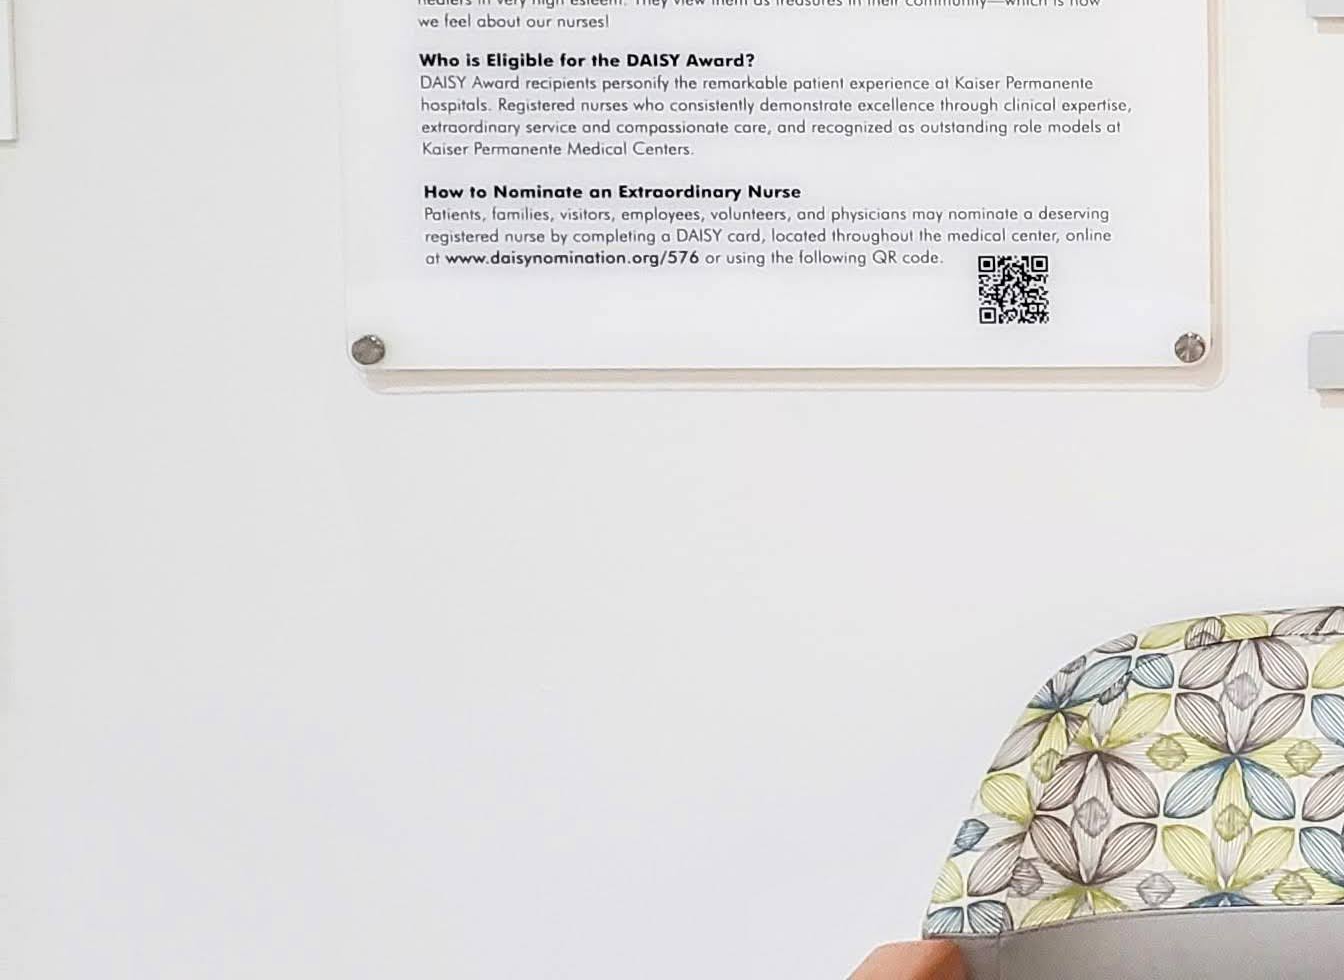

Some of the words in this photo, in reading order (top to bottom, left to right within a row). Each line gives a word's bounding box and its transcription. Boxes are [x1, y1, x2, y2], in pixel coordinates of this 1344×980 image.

[419, 52, 459, 67] Who
[466, 53, 480, 67] is
[486, 52, 554, 70] Eligible
[560, 52, 586, 67] for
[591, 52, 620, 67] the
[627, 53, 680, 67] DAISY
[686, 53, 754, 67] Award?
[422, 141, 469, 155] Kaiser
[474, 141, 562, 155] Permanente
[567, 141, 627, 155] Medical
[632, 140, 693, 155] Centers.
[424, 185, 463, 198] How
[469, 186, 487, 198] to
[493, 184, 582, 198] Nominate
[589, 188, 611, 198] an
[618, 184, 741, 202] Extraordinary
[748, 184, 801, 198] Nurse
[425, 253, 440, 264] at
[445, 249, 699, 267] www.daisynomination.org/576
[705, 254, 720, 264] or
[726, 251, 765, 267] using
[771, 250, 793, 264] the
[799, 249, 866, 267] following
[872, 249, 897, 264] QR
[902, 249, 943, 263] code.
